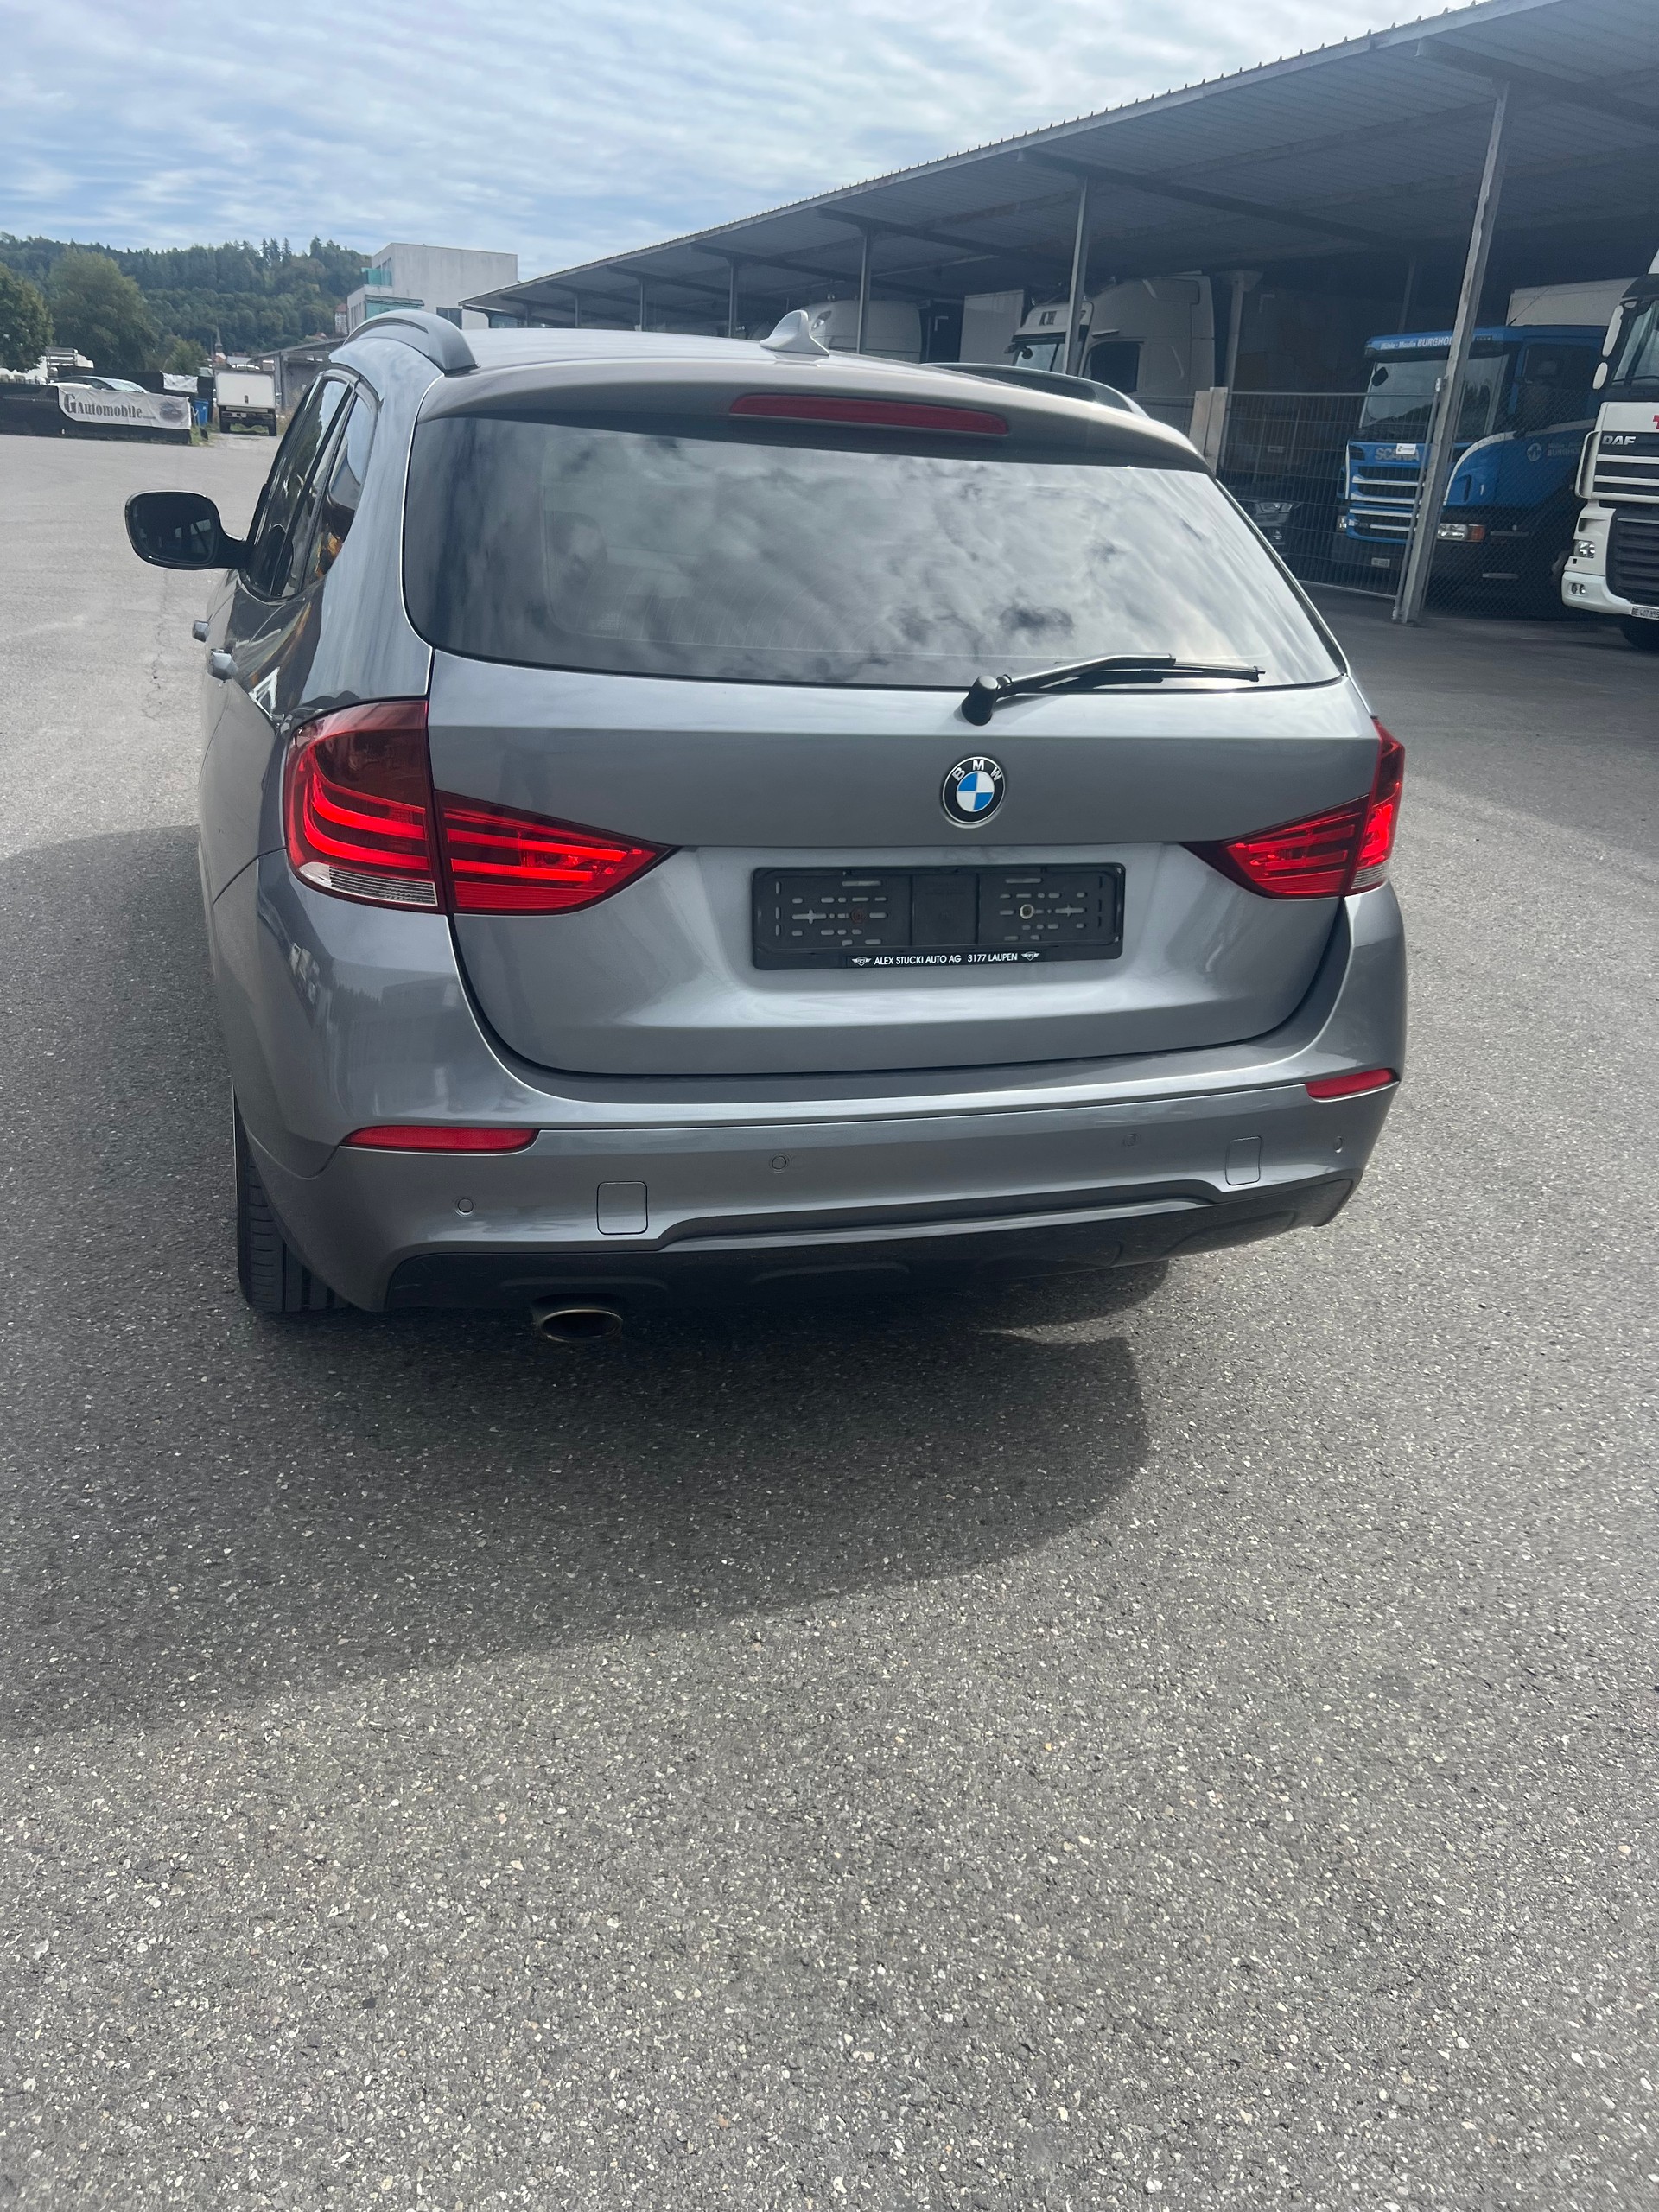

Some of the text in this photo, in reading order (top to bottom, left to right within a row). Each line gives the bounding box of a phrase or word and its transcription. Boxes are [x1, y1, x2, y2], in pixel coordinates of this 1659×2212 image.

[1602, 435, 1636, 445] DAF
[951, 760, 1002, 781] BMW
[874, 957, 894, 965] ALEX
[895, 956, 924, 964] STUCKI
[925, 955, 947, 963] AUTO
[948, 955, 962, 963] AG
